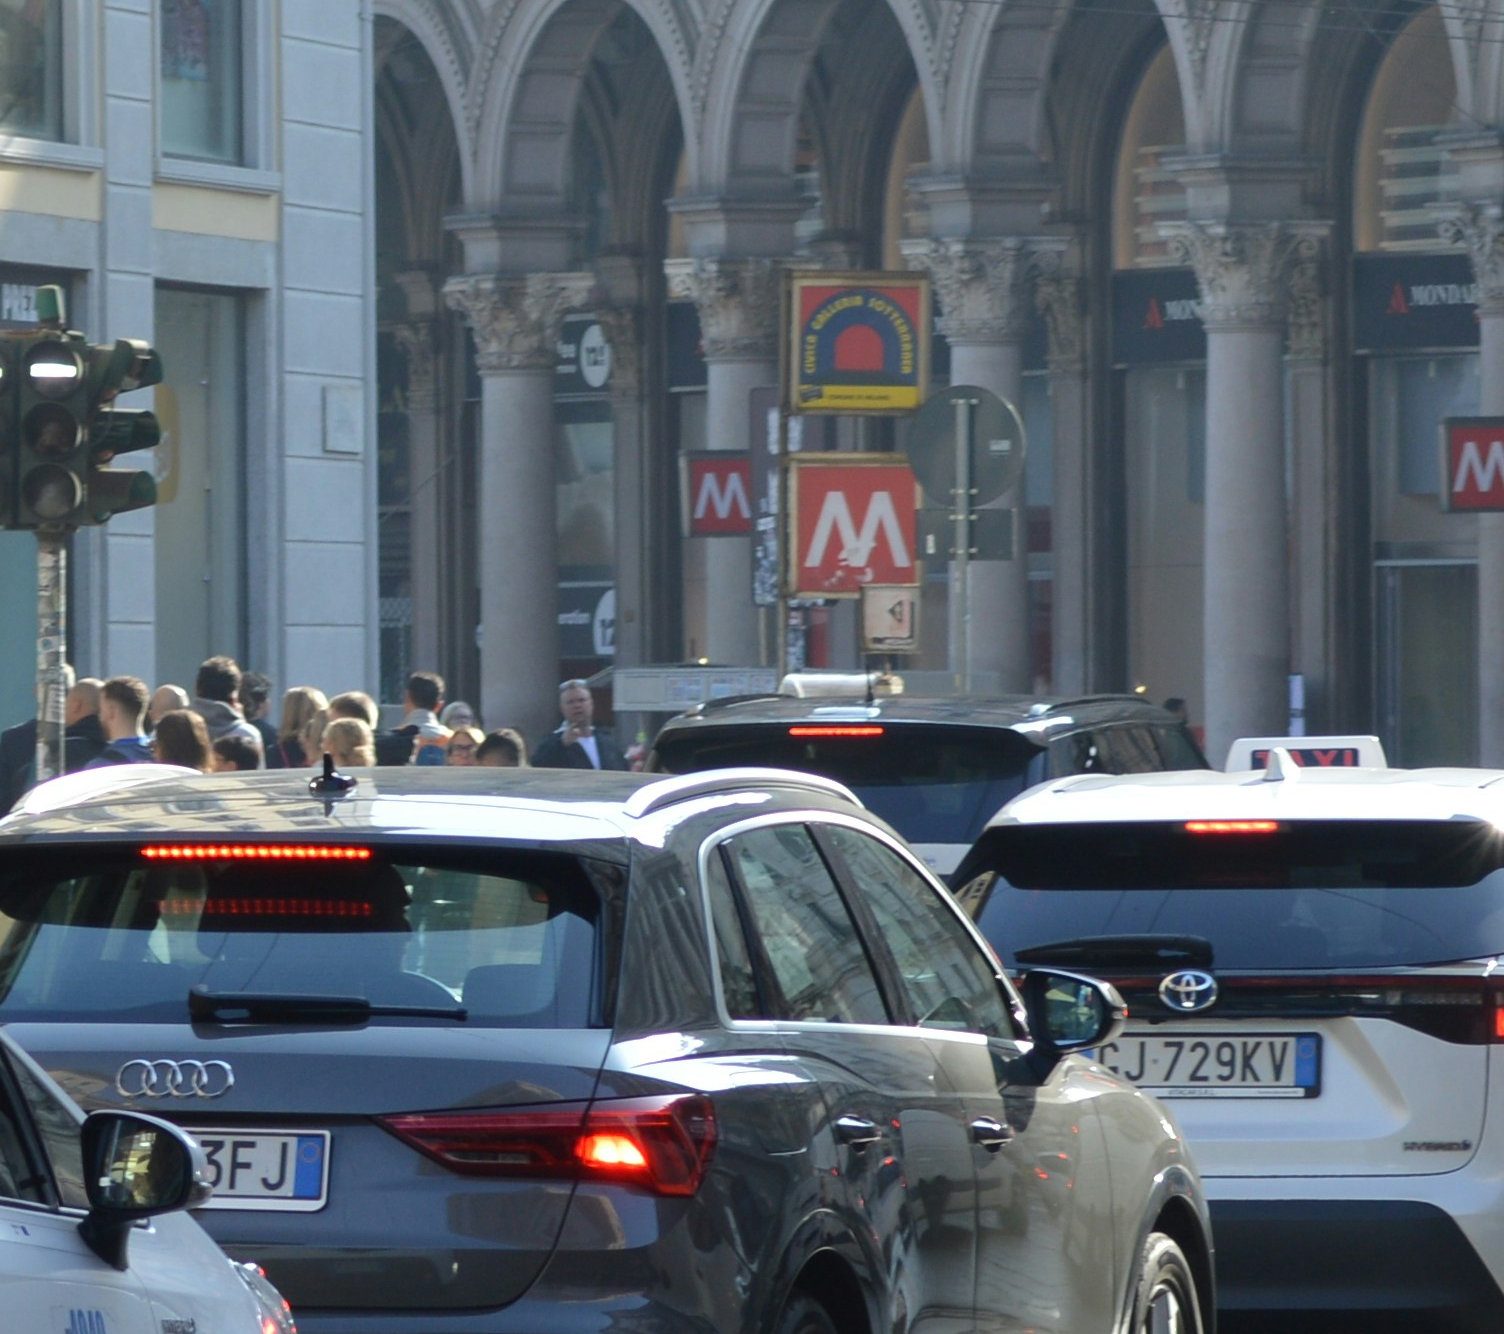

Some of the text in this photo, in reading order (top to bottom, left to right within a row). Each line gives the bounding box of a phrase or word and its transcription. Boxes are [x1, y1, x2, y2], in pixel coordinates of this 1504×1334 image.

[1409, 283, 1477, 307] MONDA
[694, 472, 751, 519] M
[804, 490, 911, 568] M
[1162, 1040, 1289, 1083] 729KV
[200, 1140, 289, 1192] 3FJ
